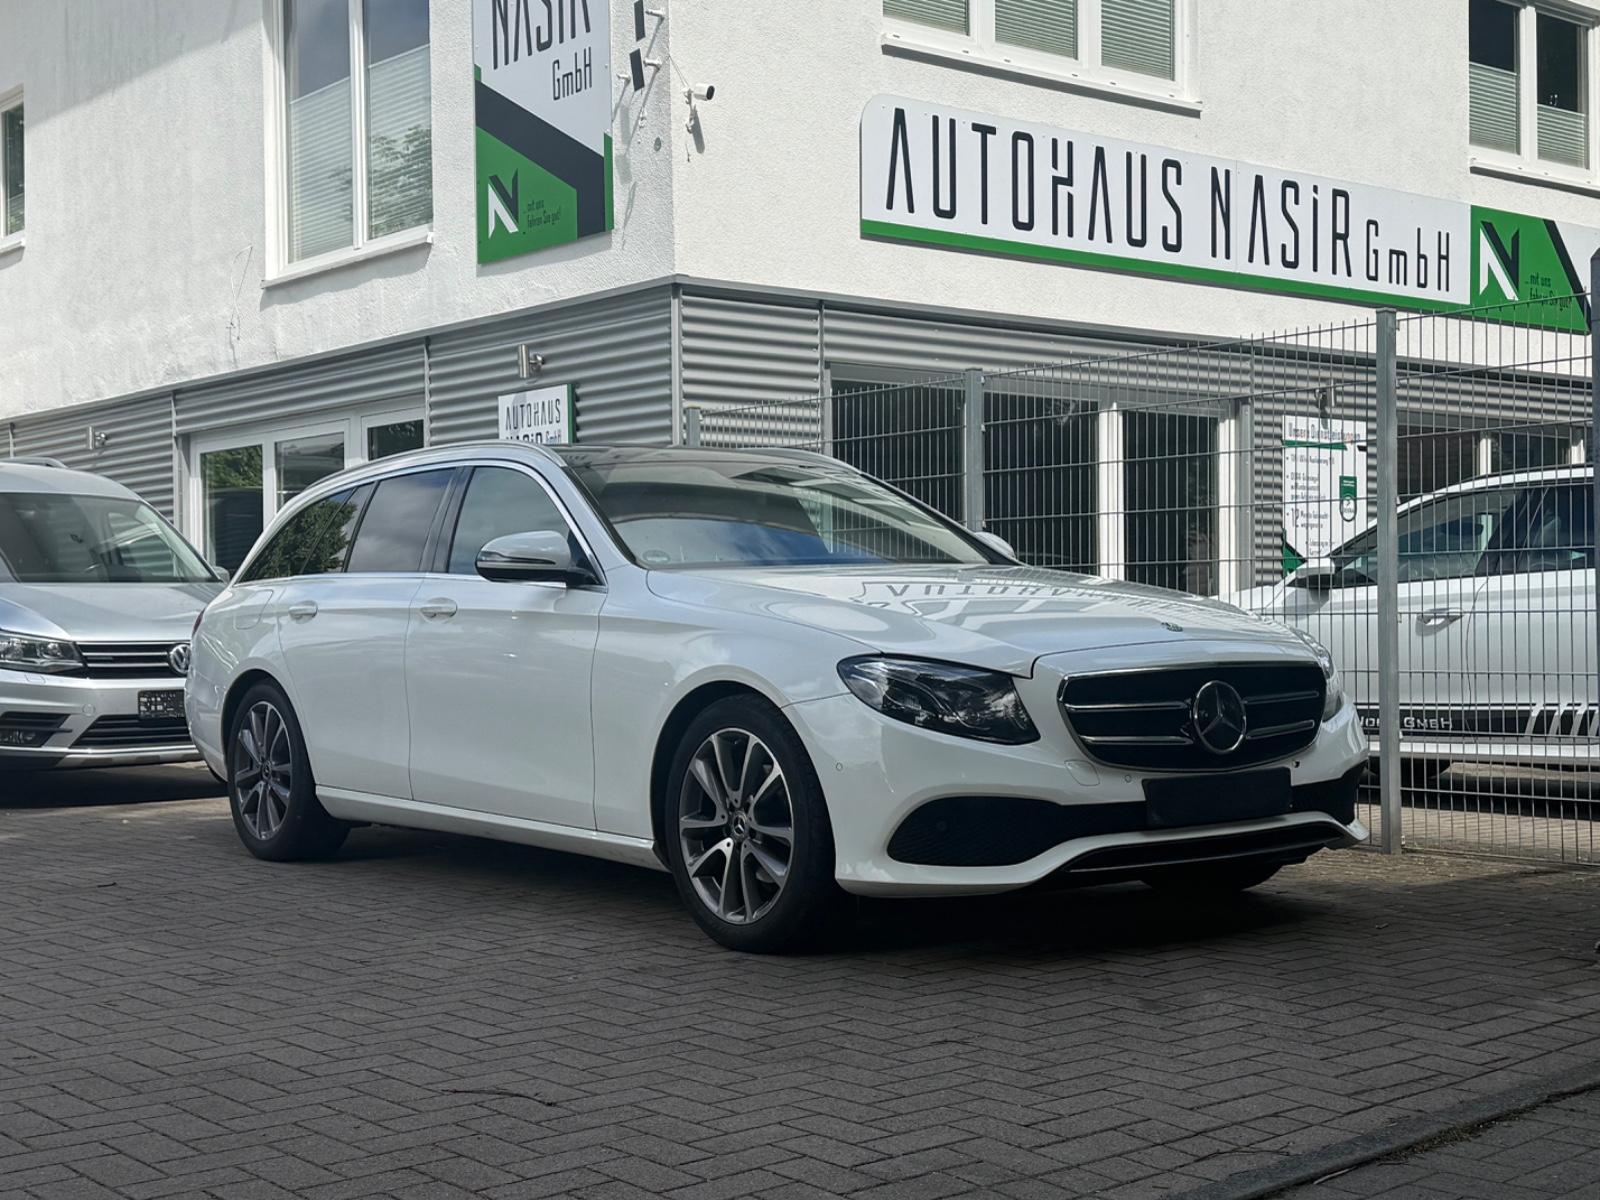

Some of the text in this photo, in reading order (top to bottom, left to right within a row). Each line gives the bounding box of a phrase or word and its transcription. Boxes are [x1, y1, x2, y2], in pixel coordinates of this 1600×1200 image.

[552, 46, 592, 101] GmbH
[886, 107, 1182, 253] AUTOHAUS
[1366, 219, 1450, 292] GmbH
[505, 398, 561, 431] AUTOHAUS
